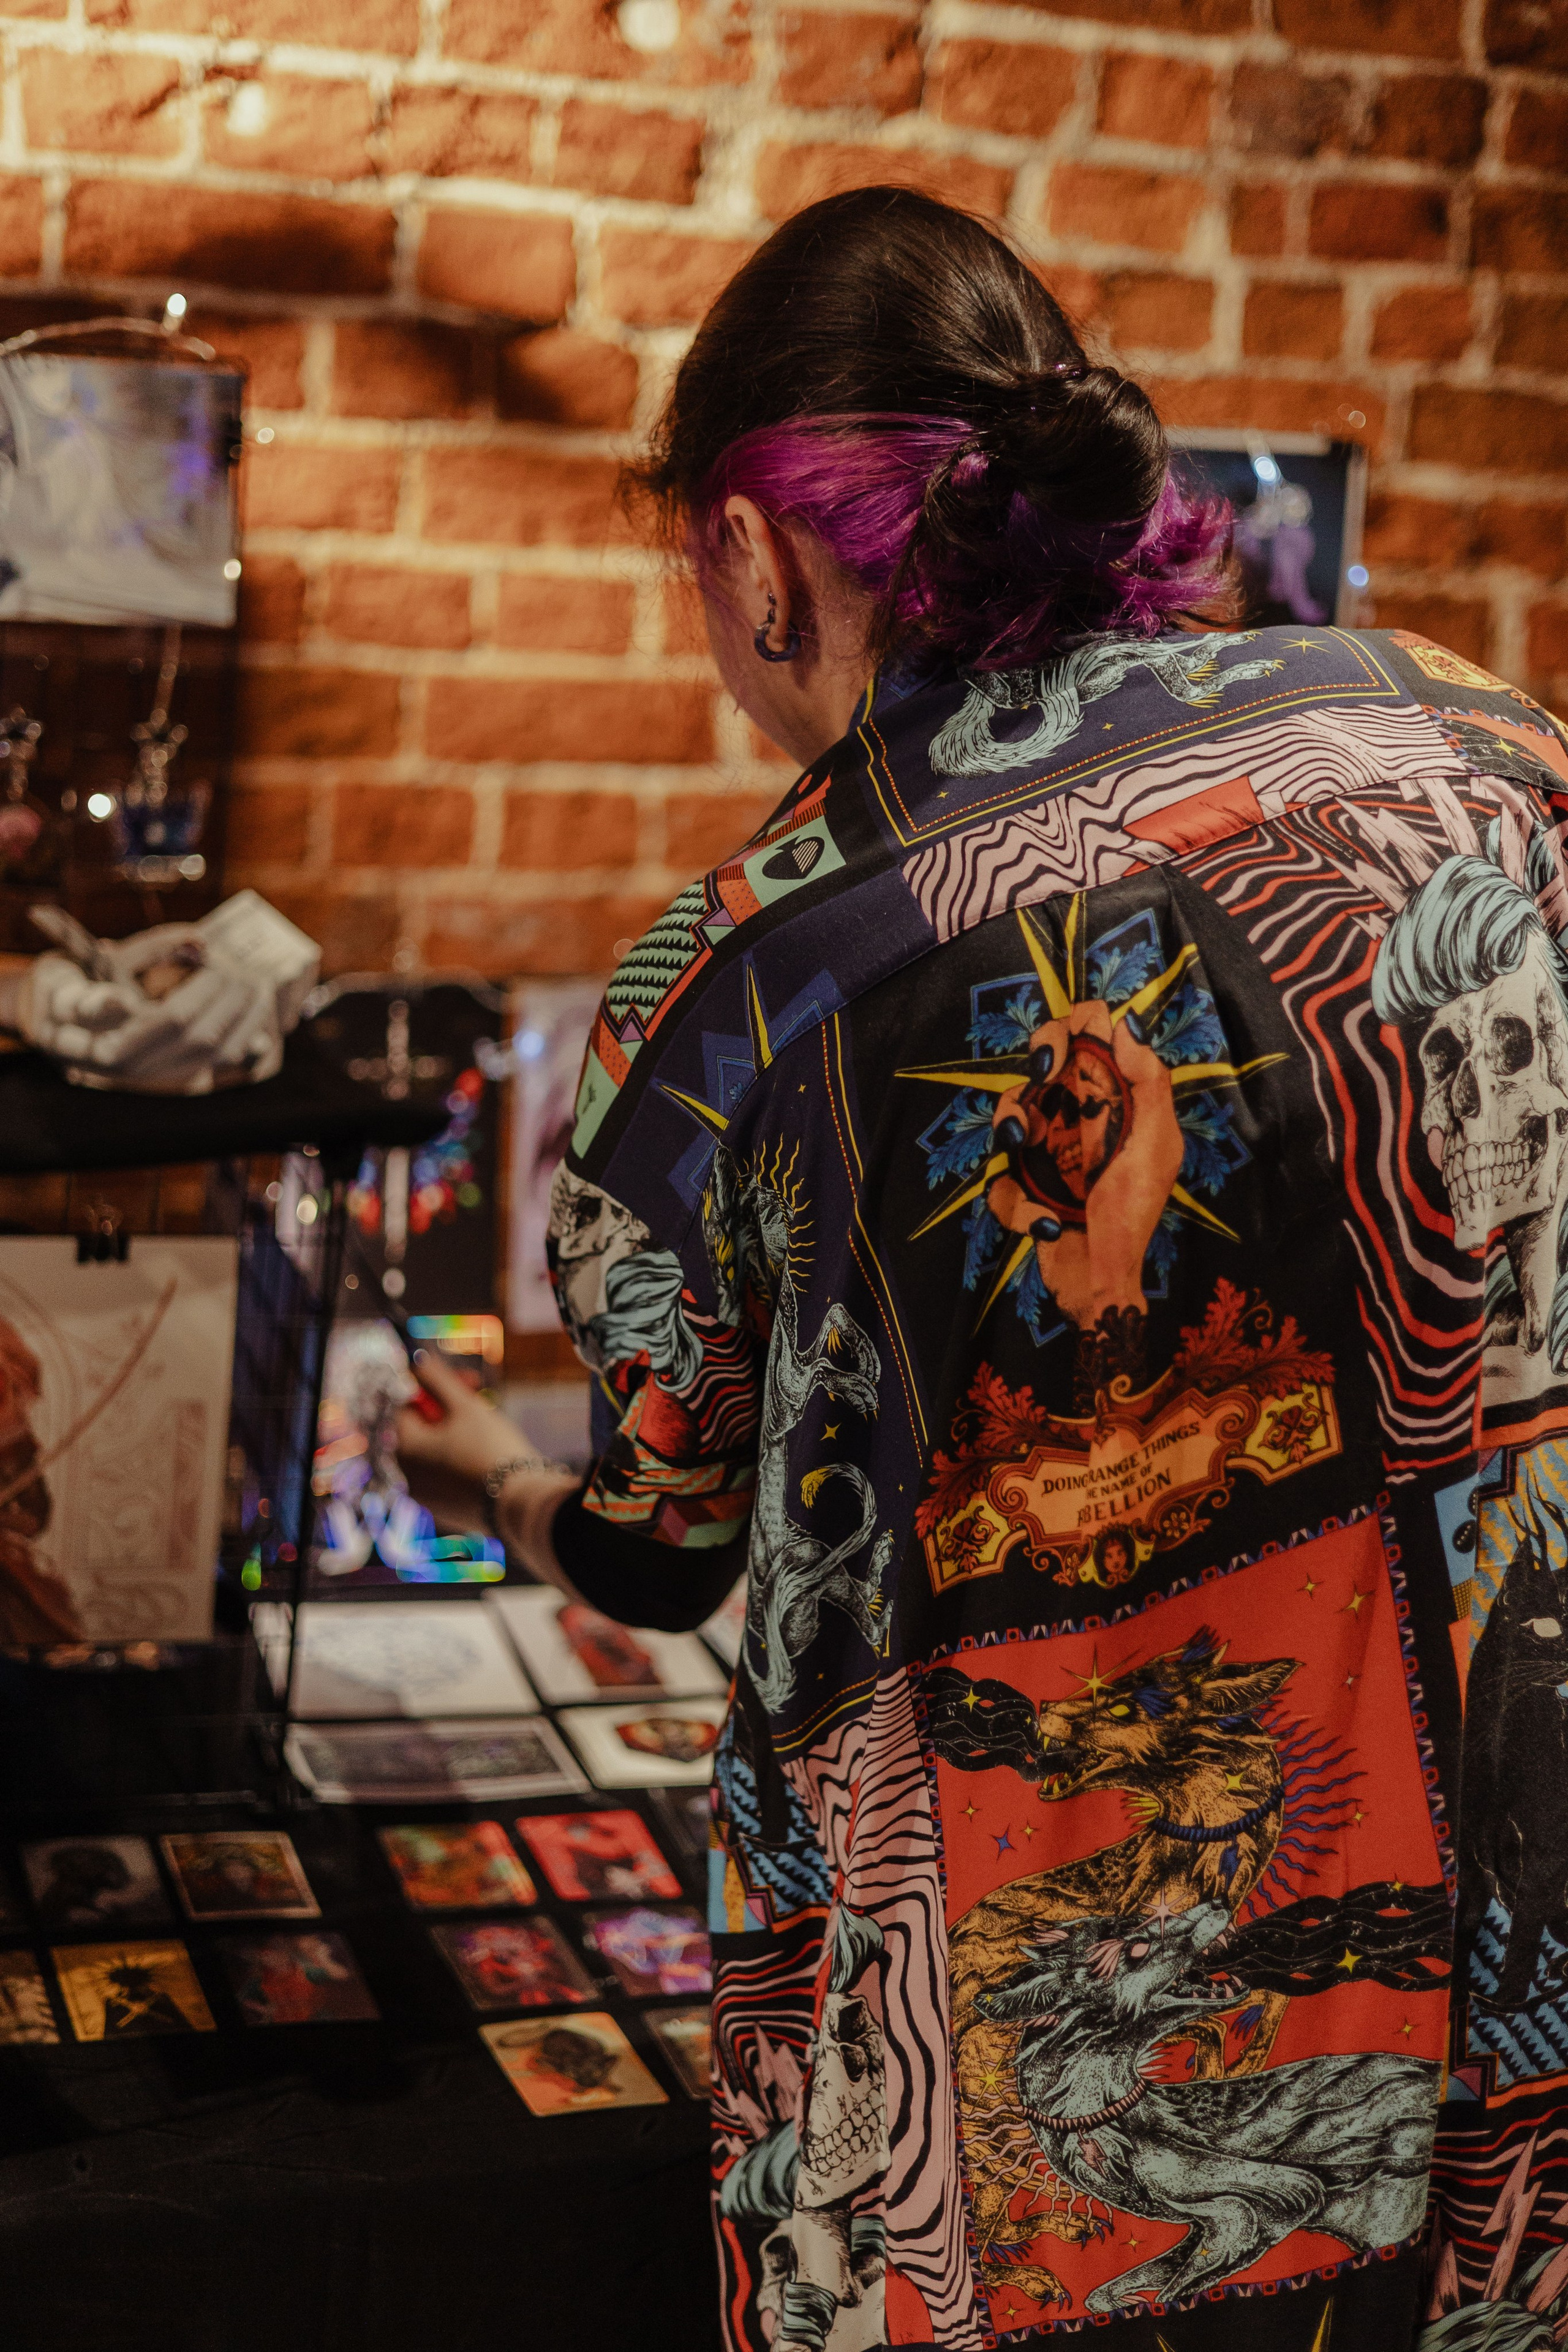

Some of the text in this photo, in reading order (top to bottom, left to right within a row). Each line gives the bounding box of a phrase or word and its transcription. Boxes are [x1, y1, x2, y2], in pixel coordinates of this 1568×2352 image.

[1141, 1421, 1200, 1460] THINGS
[1100, 1472, 1137, 1496] NAME
[1140, 1461, 1153, 1477] OF
